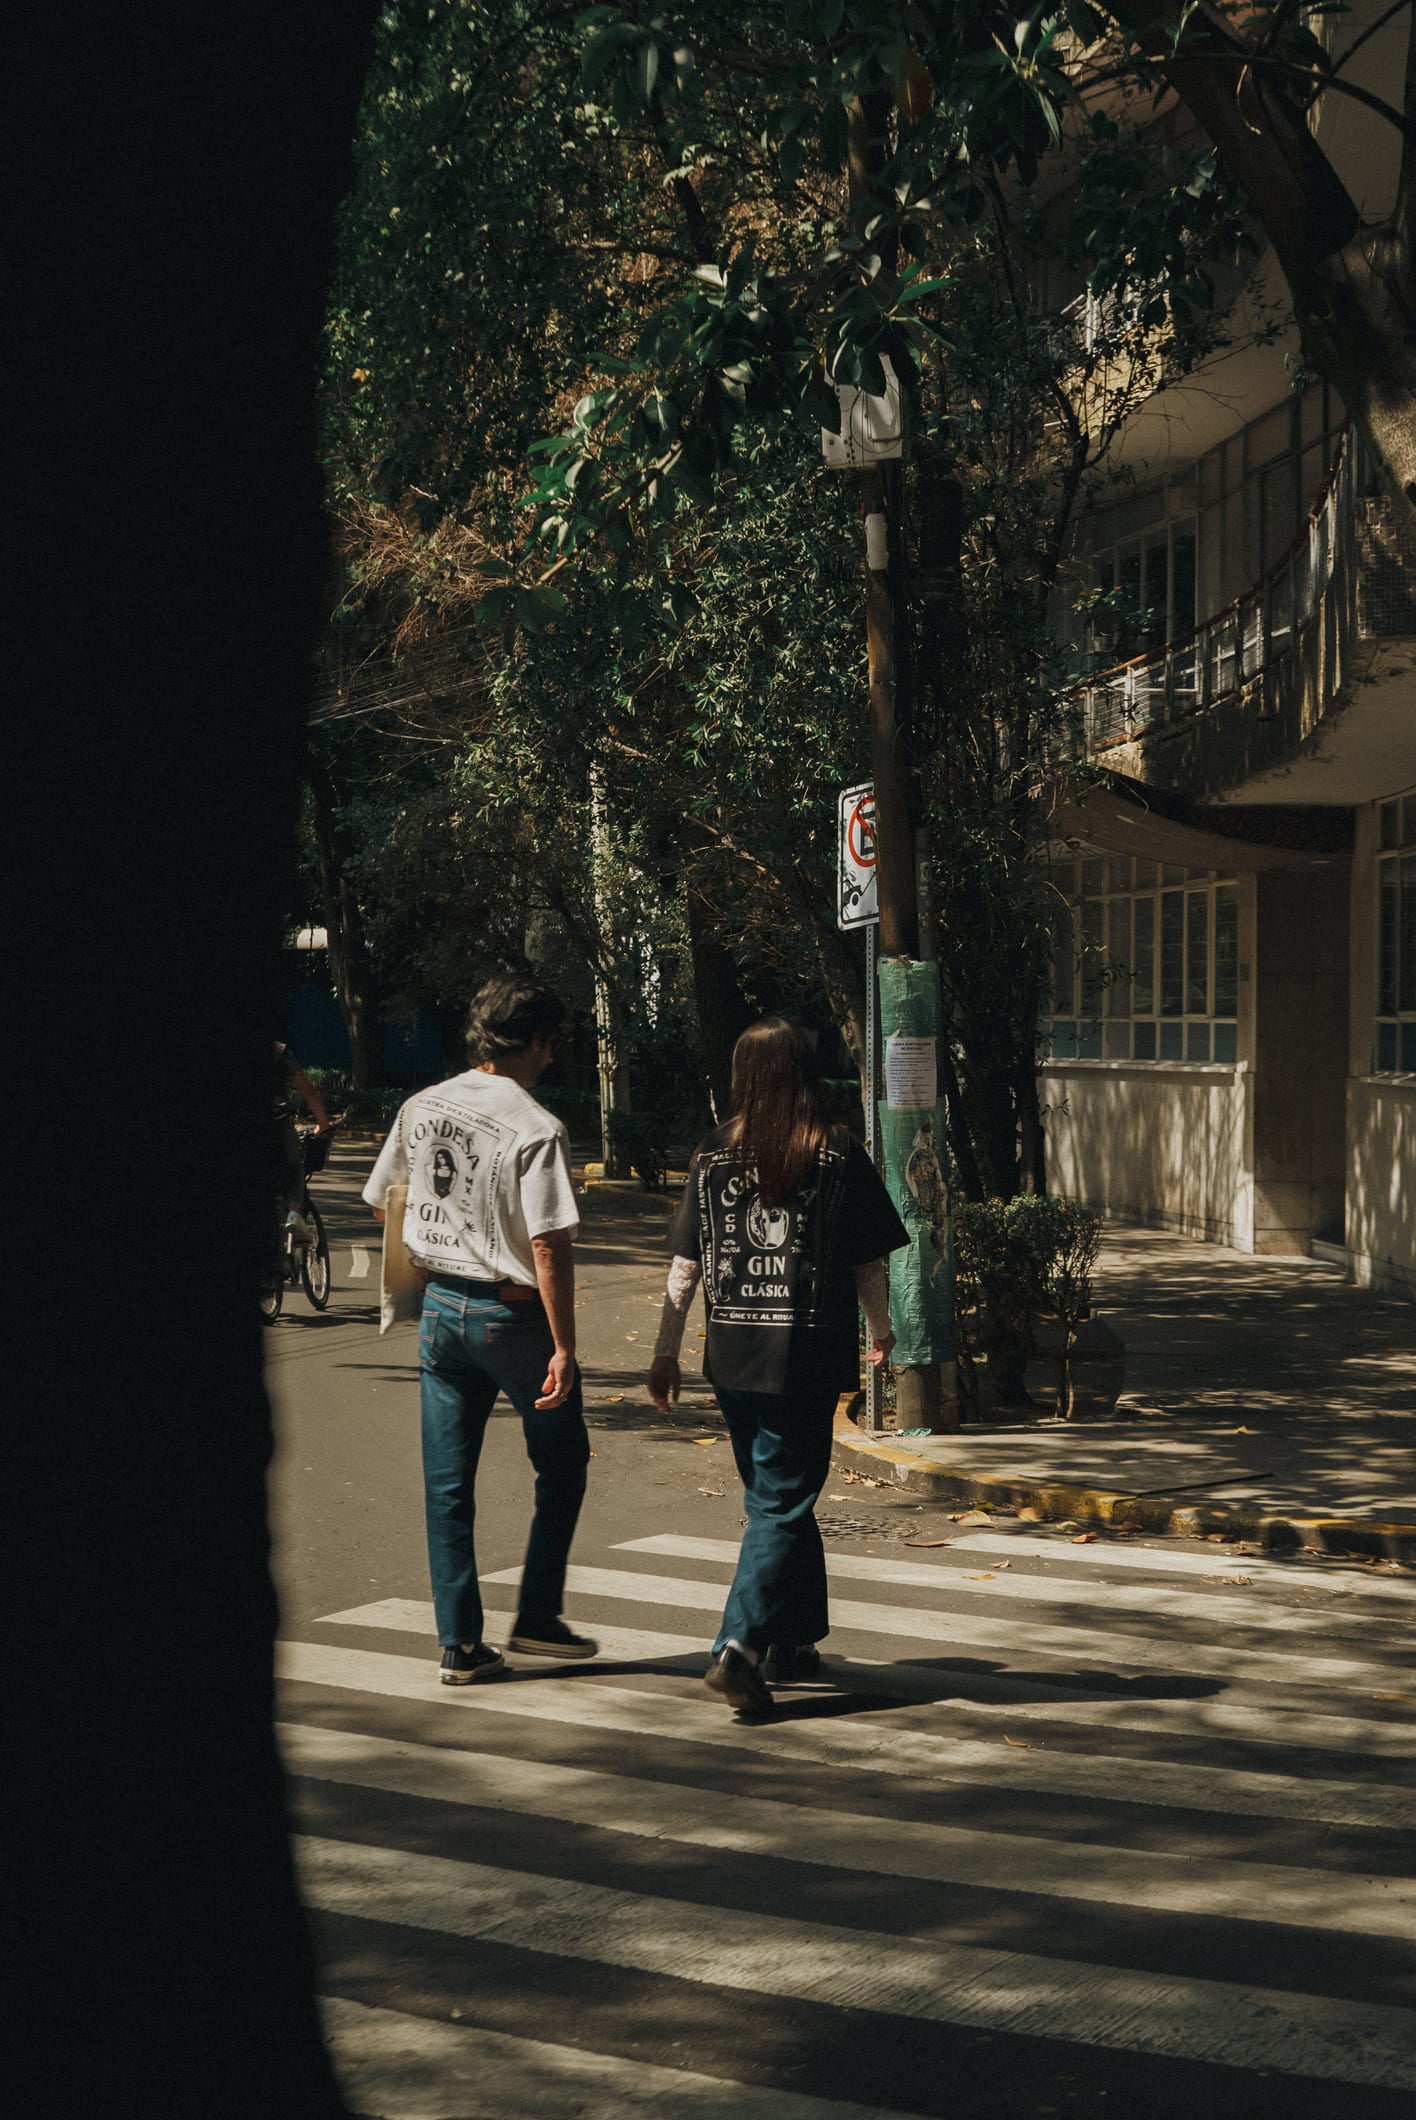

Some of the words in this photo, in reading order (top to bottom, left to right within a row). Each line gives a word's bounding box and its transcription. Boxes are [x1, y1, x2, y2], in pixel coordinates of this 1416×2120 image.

[407, 1118, 480, 1171] CONDESA
[747, 1255, 786, 1276] GIN
[740, 1281, 790, 1298] CLÁSICA
